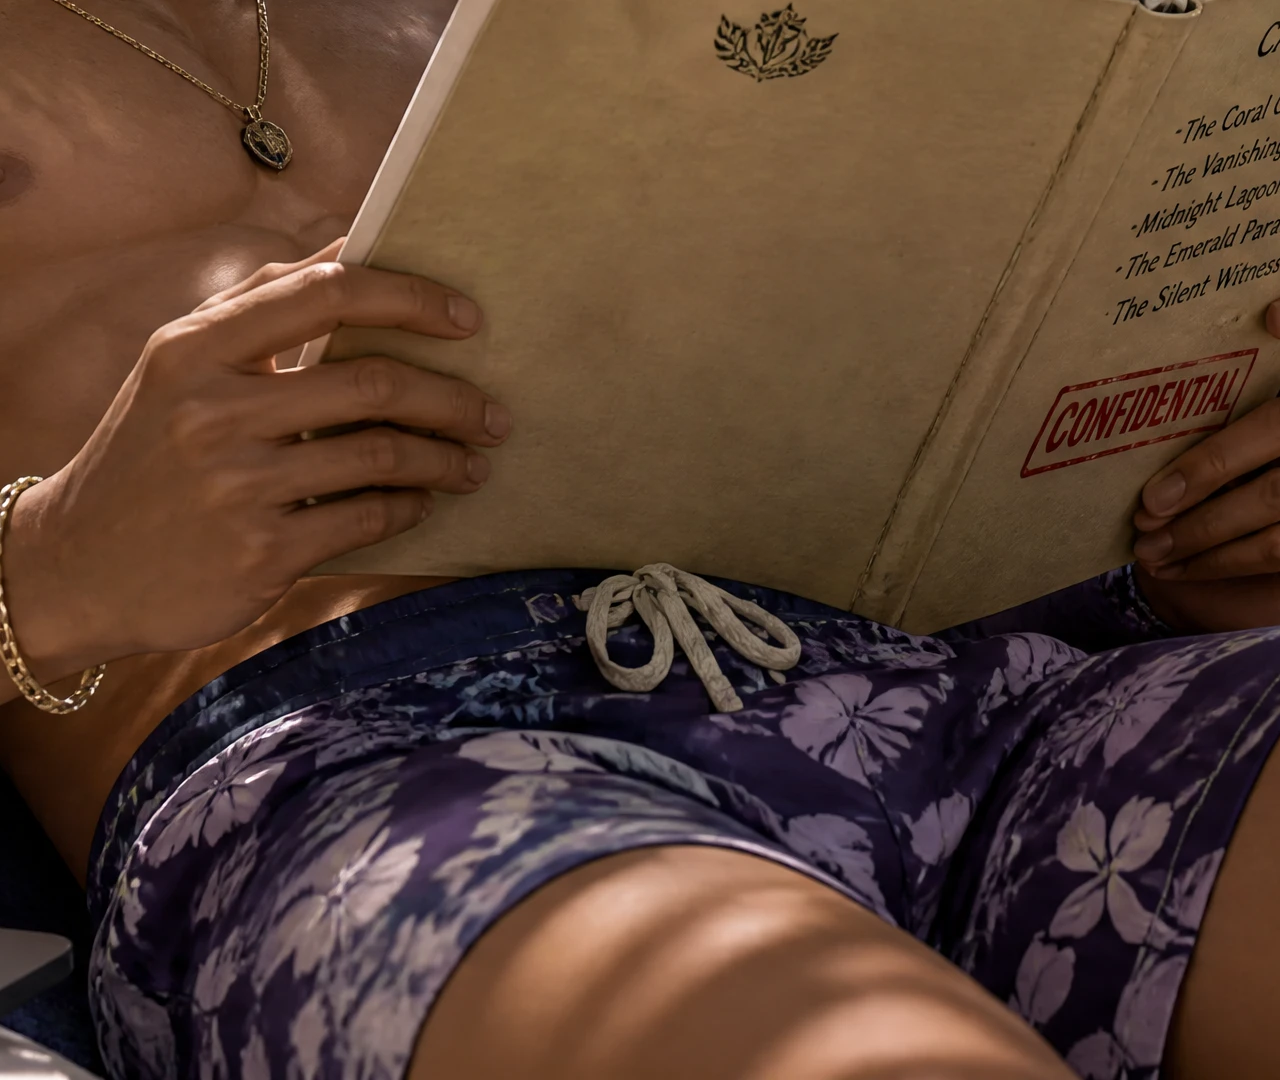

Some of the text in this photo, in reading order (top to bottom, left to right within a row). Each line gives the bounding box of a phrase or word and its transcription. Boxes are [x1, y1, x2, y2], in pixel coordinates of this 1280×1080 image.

[1221, 95, 1272, 132] Coral
[1163, 220, 1237, 268] Emerald
[1152, 277, 1211, 313] Silent
[1046, 368, 1240, 453] CONFIDENTIAL
